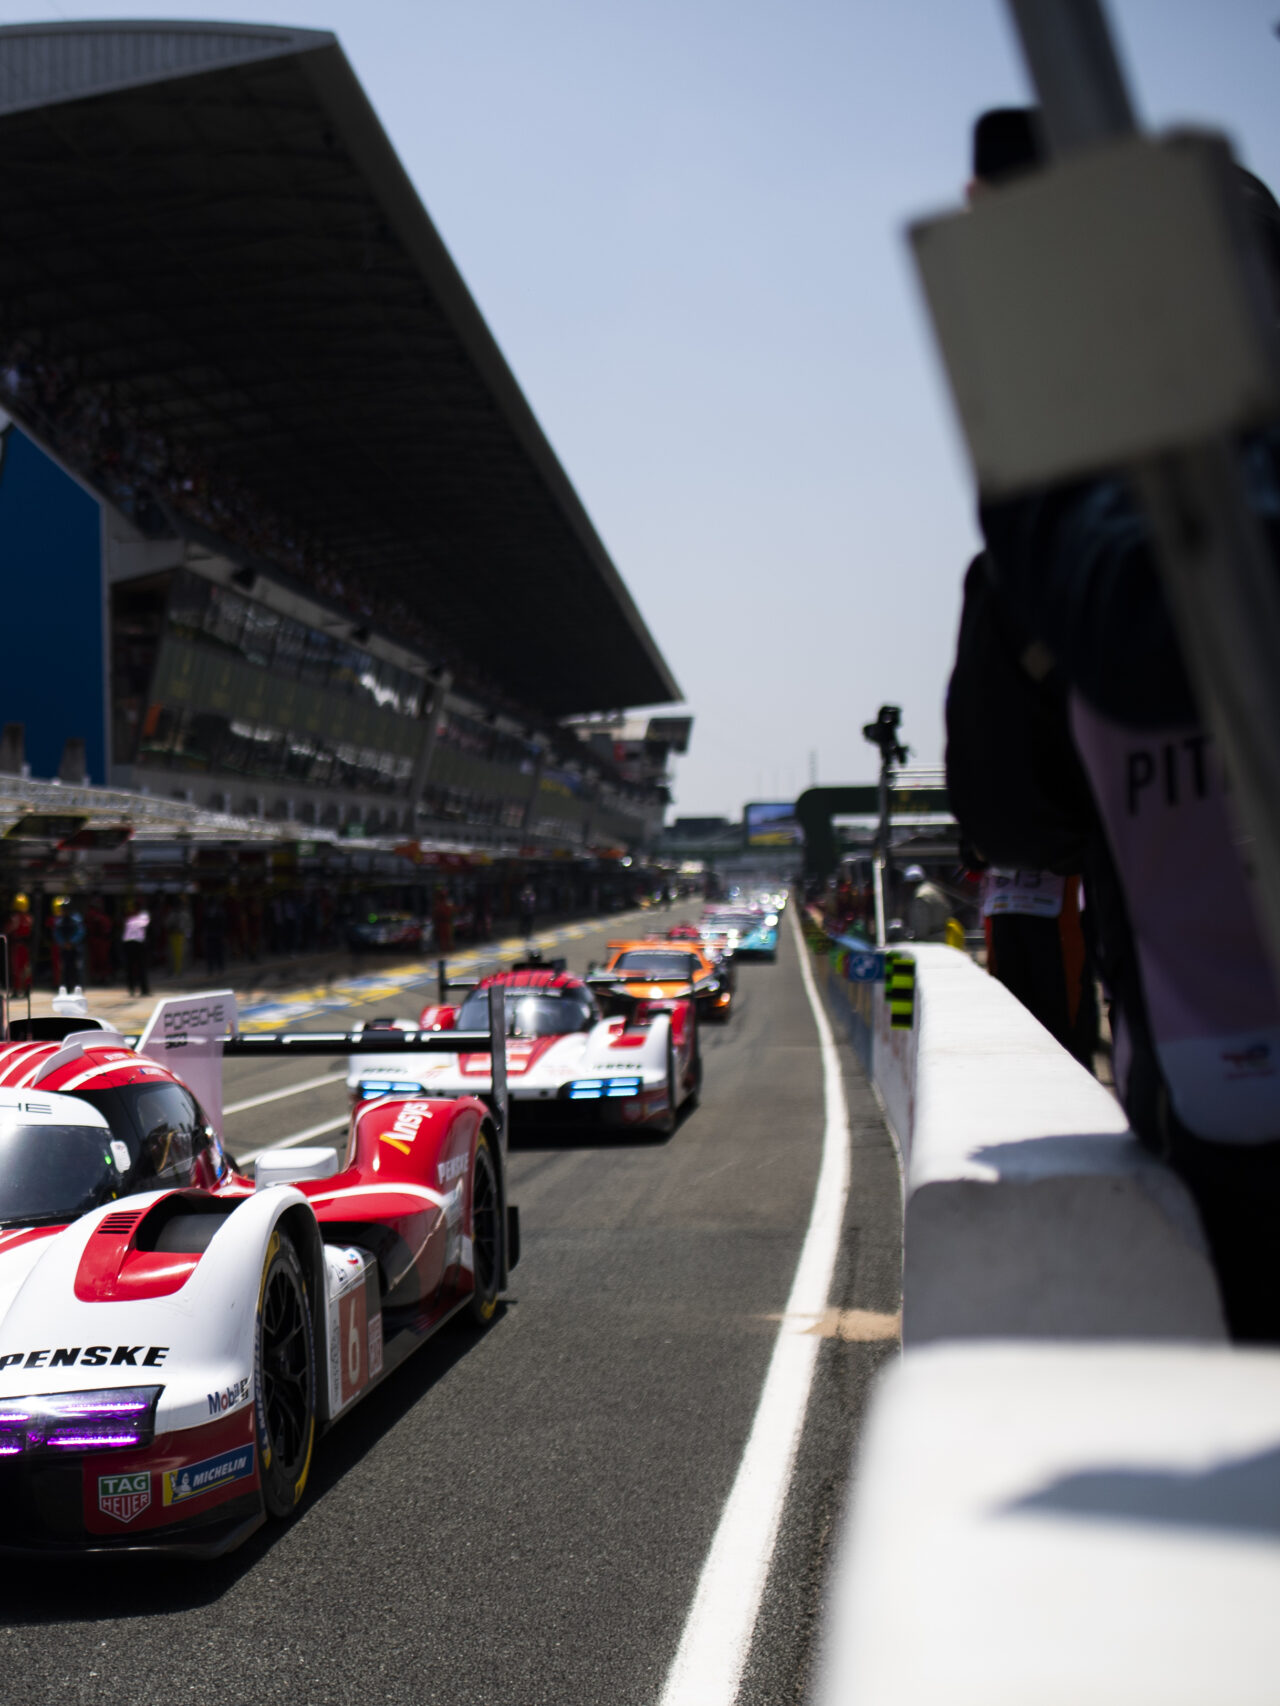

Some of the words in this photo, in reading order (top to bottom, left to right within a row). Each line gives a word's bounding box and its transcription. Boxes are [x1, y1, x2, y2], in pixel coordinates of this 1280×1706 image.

[164, 1005, 224, 1031] PORSCHE
[380, 1102, 433, 1155] Ansys
[348, 1298, 361, 1386] 6
[103, 1476, 147, 1493] TAG
[192, 1456, 248, 1487] MICHELIN
[102, 1494, 148, 1518] HEUER
